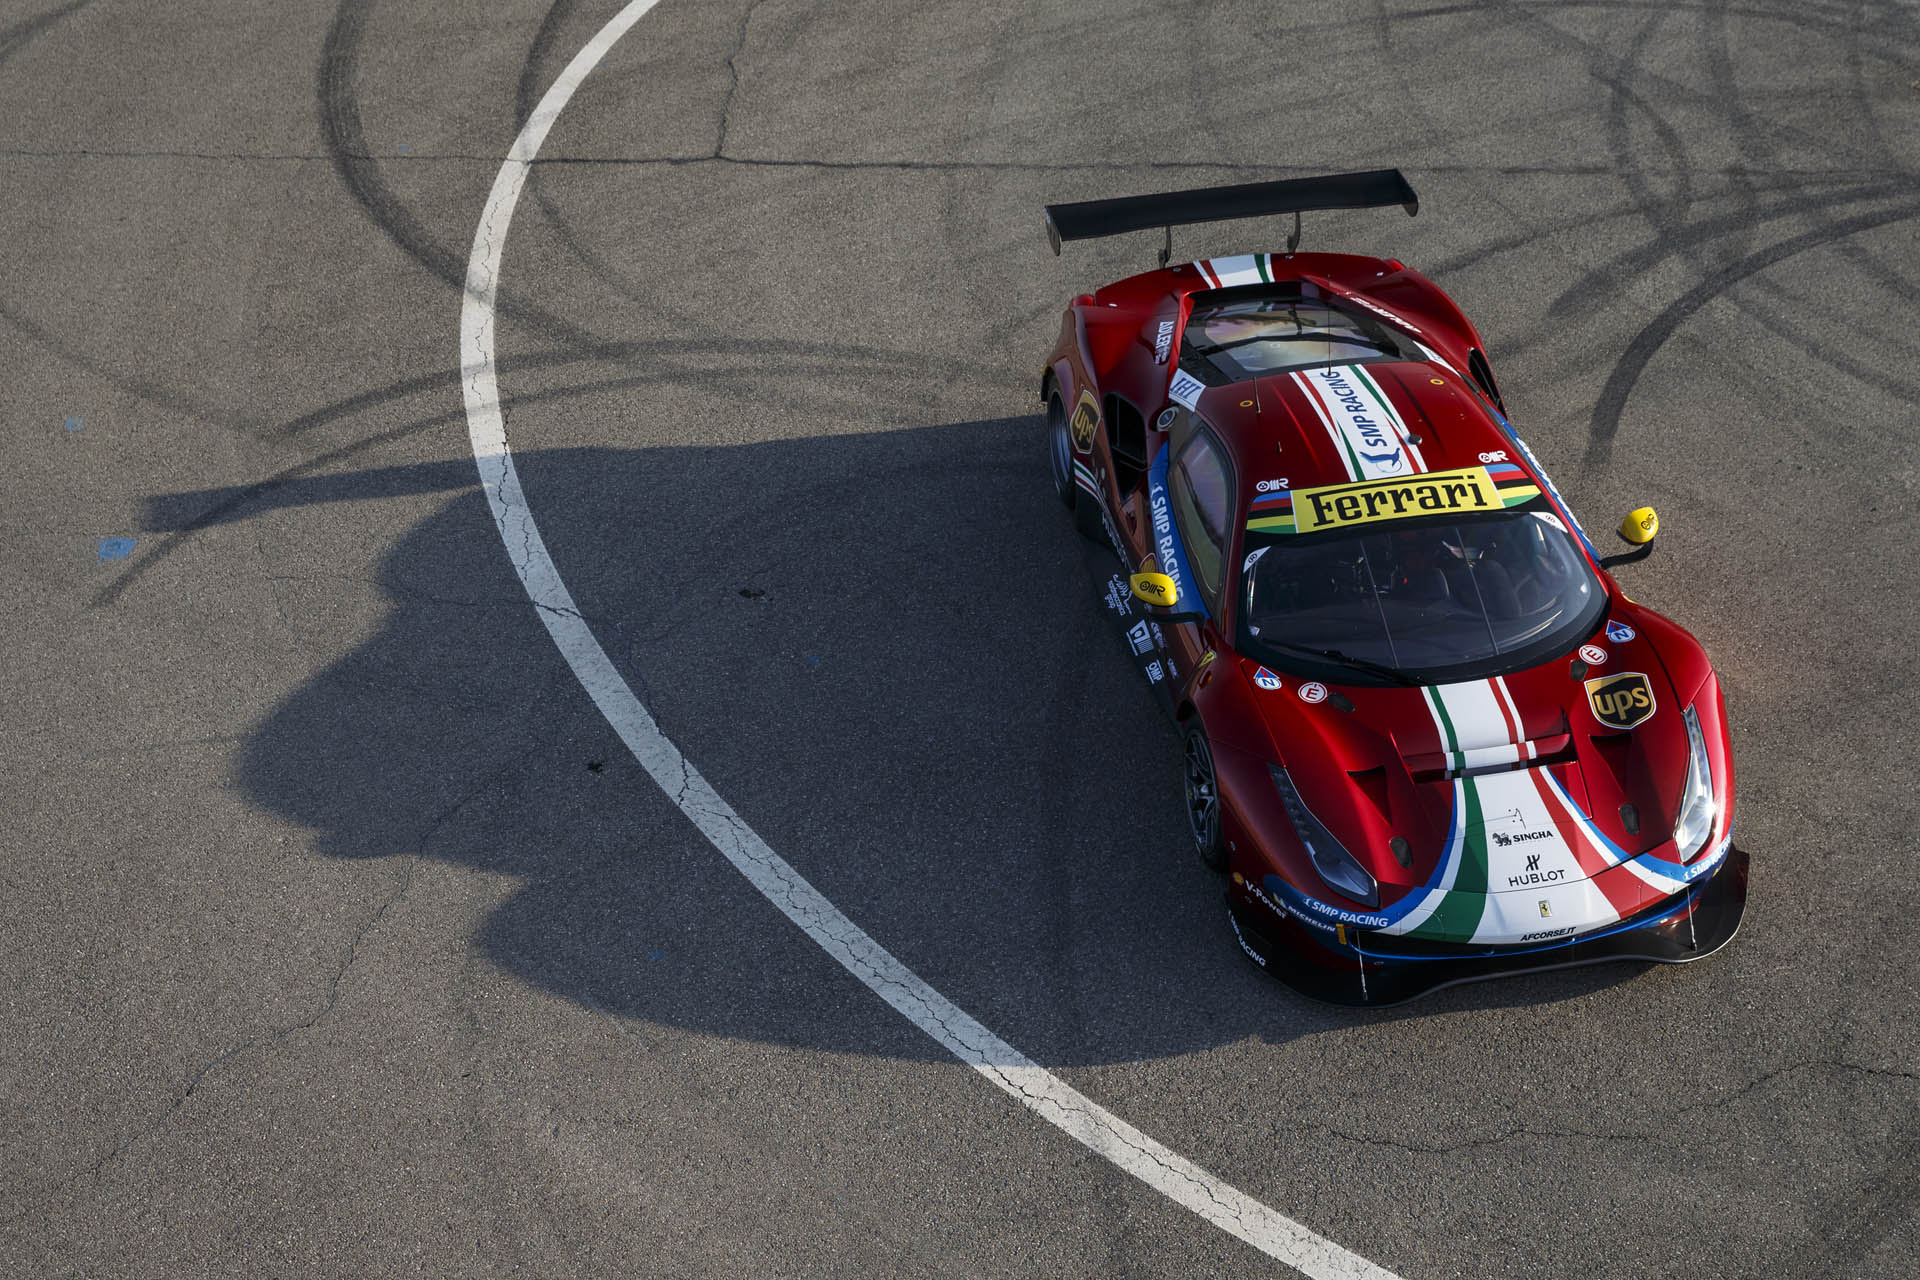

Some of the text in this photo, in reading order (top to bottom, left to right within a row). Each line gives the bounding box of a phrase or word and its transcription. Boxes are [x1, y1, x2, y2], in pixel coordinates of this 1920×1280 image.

[1156, 320, 1174, 350] ADLER
[1170, 378, 1199, 399] IHI
[1320, 371, 1387, 447] SMP RACING
[1306, 475, 1487, 527] Ferrari
[1151, 496, 1171, 534] SMP
[1149, 662, 1162, 681] OMP
[1513, 830, 1553, 842] SINGHA
[1508, 870, 1564, 887] HUBLOT
[1245, 880, 1287, 919] V-Power
[1288, 905, 1336, 932] MICHELIN
[1311, 901, 1389, 928] SMP RACING
[1520, 926, 1577, 942] AFCORSE.IT
